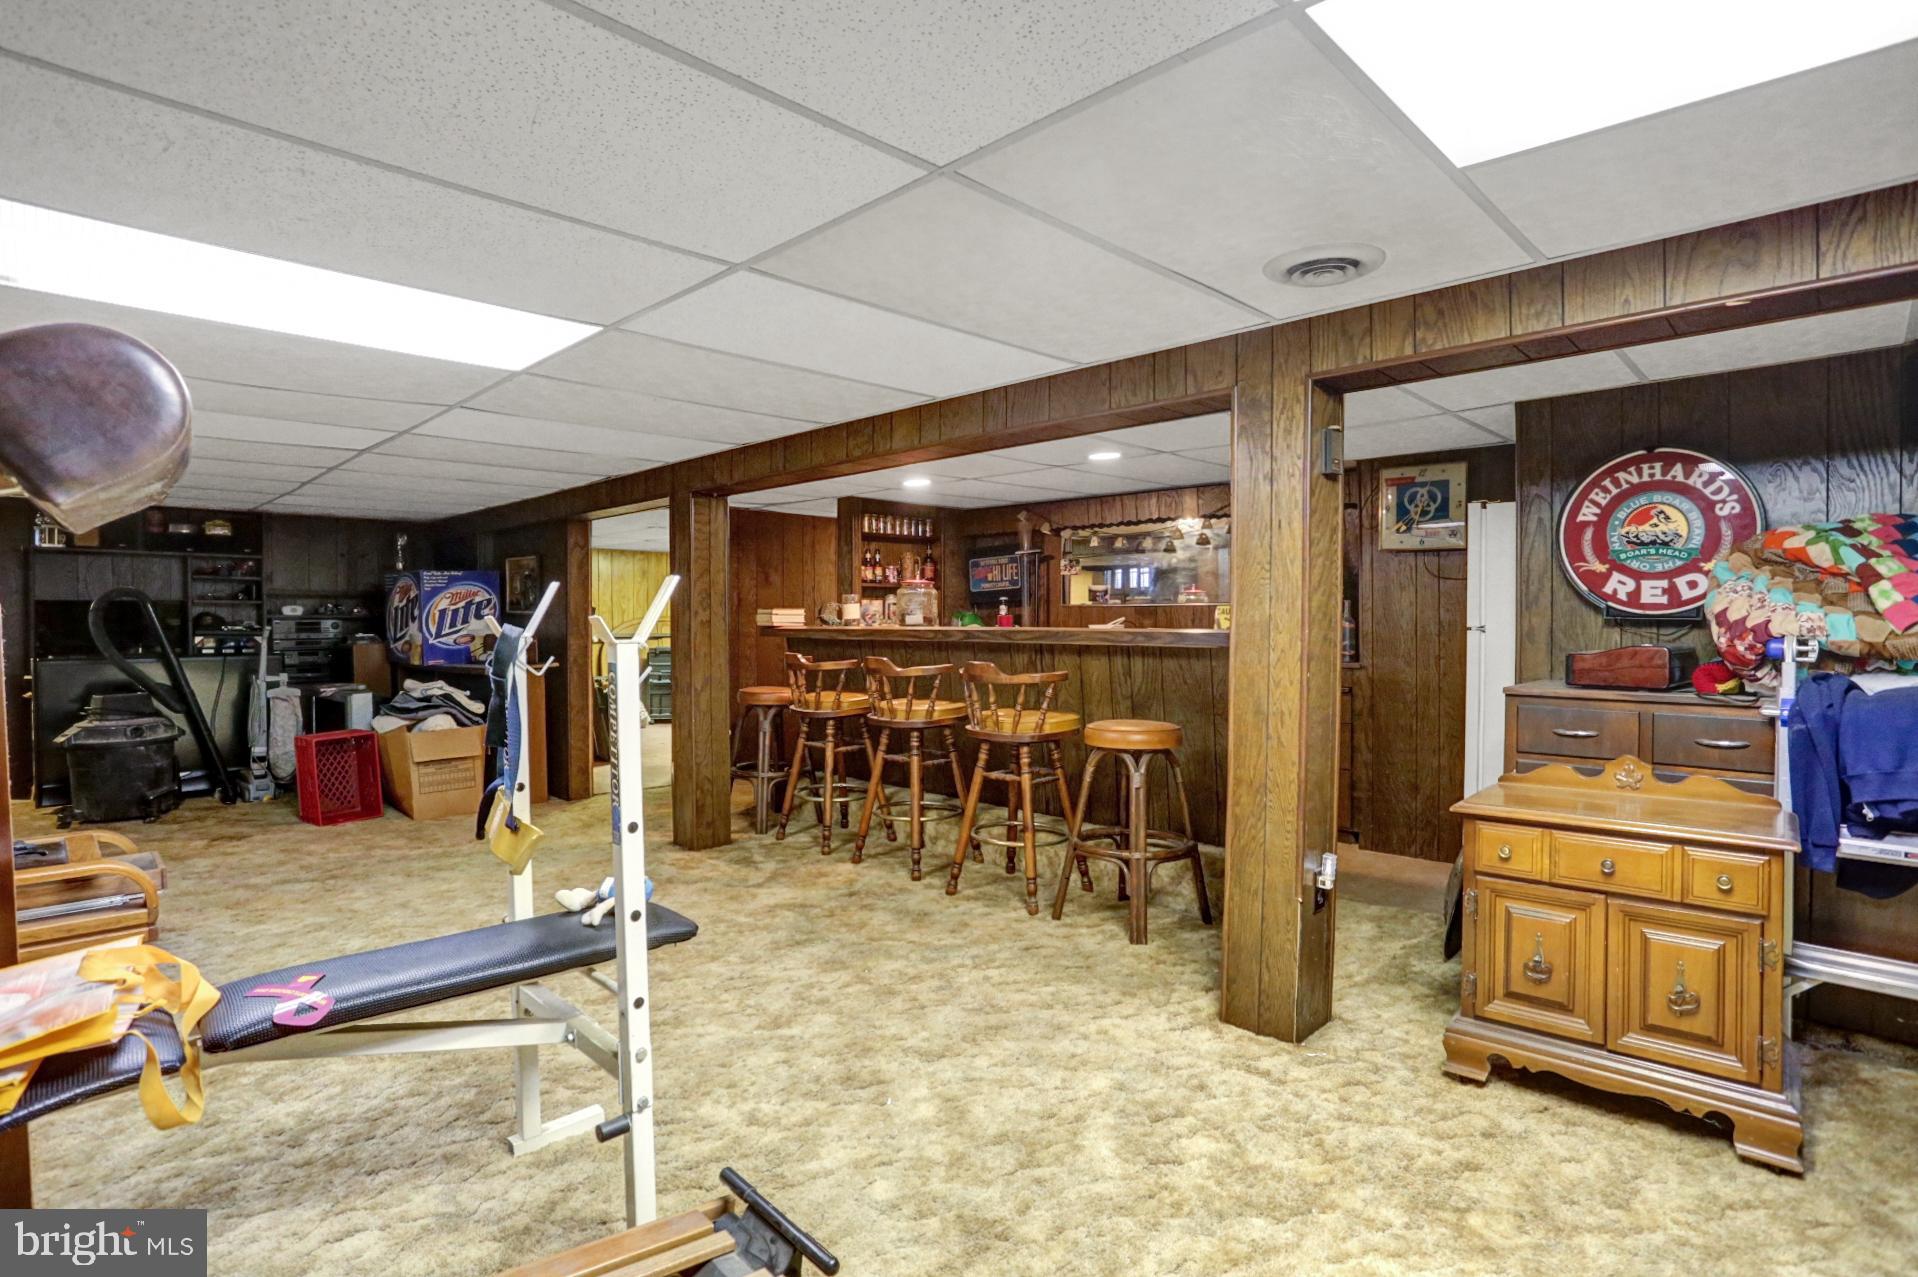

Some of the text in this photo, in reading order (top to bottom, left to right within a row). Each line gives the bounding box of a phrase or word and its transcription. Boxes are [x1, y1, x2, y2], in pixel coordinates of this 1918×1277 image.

[1575, 461, 1741, 523] WEINHARD'S
[1616, 495, 1649, 519] BLUE
[1652, 494, 1689, 512] BOAR
[1619, 548, 1688, 560] BOAR'S HEAD
[1655, 559, 1683, 570] THE
[1002, 563, 1018, 580] LIFE
[443, 589, 482, 606] Miller
[1602, 570, 1707, 605] RED
[430, 595, 496, 643] Lite
[608, 671, 621, 808] COMPETITOR
